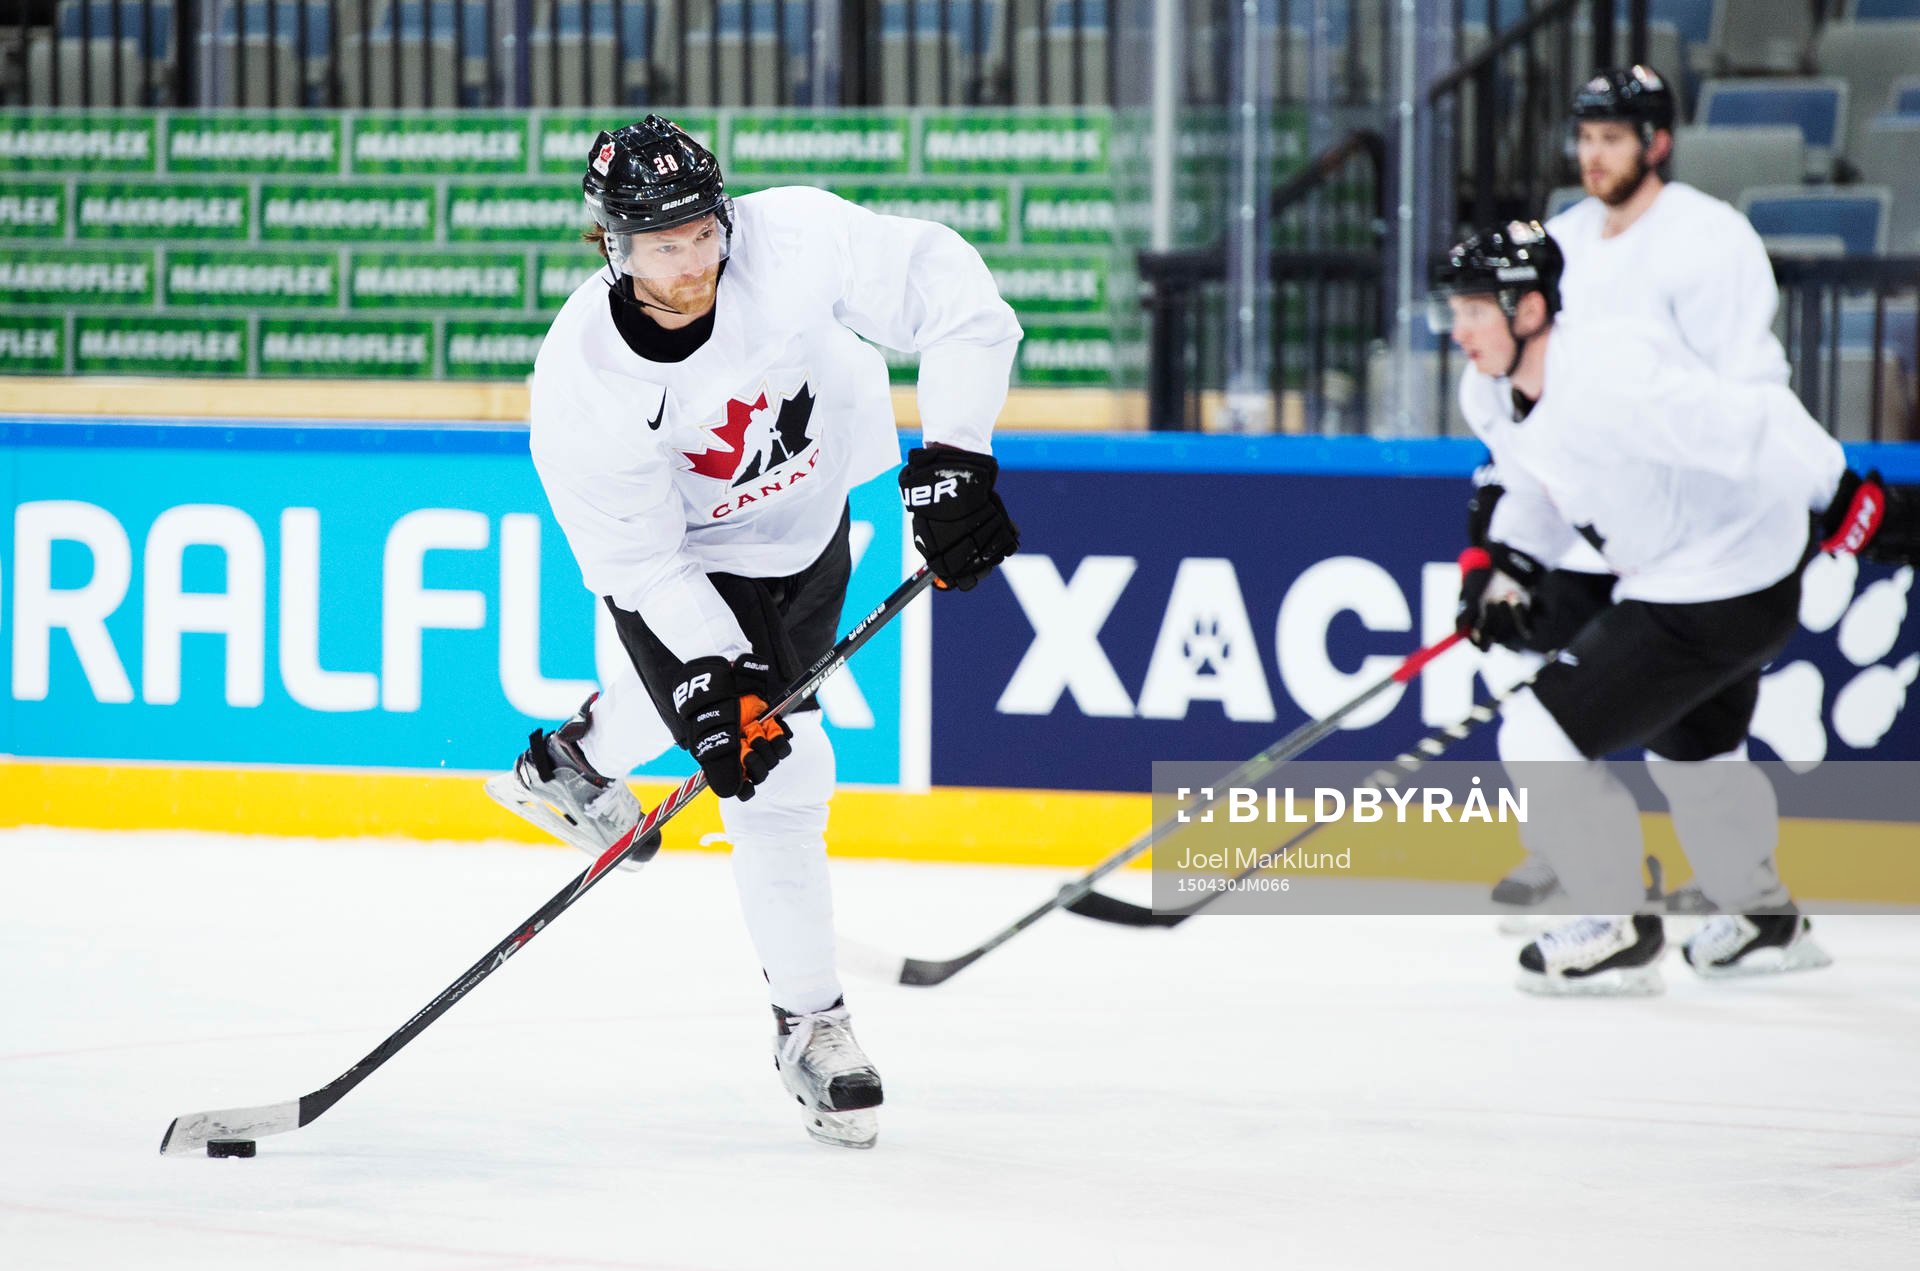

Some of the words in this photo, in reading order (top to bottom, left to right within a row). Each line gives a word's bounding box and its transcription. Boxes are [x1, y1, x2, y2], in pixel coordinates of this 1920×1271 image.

[171, 131, 334, 160] MAKROFLEX
[356, 132, 520, 160] MAKROFLEX
[732, 131, 901, 160] MAKROFLEX
[925, 130, 1099, 160] MAKROFLEX
[653, 154, 679, 176] 28
[80, 197, 242, 227] MAKROFLEX
[264, 198, 428, 228] MAKROFLEX
[661, 193, 700, 211] BAUER
[168, 264, 332, 295] MAKROFLEX
[353, 266, 518, 297] MAKROFLEX
[79, 330, 241, 361] MAKROFLEX
[262, 332, 427, 363] MAKROFLEX
[848, 602, 886, 641] BAUER
[809, 649, 836, 674] GIROUX
